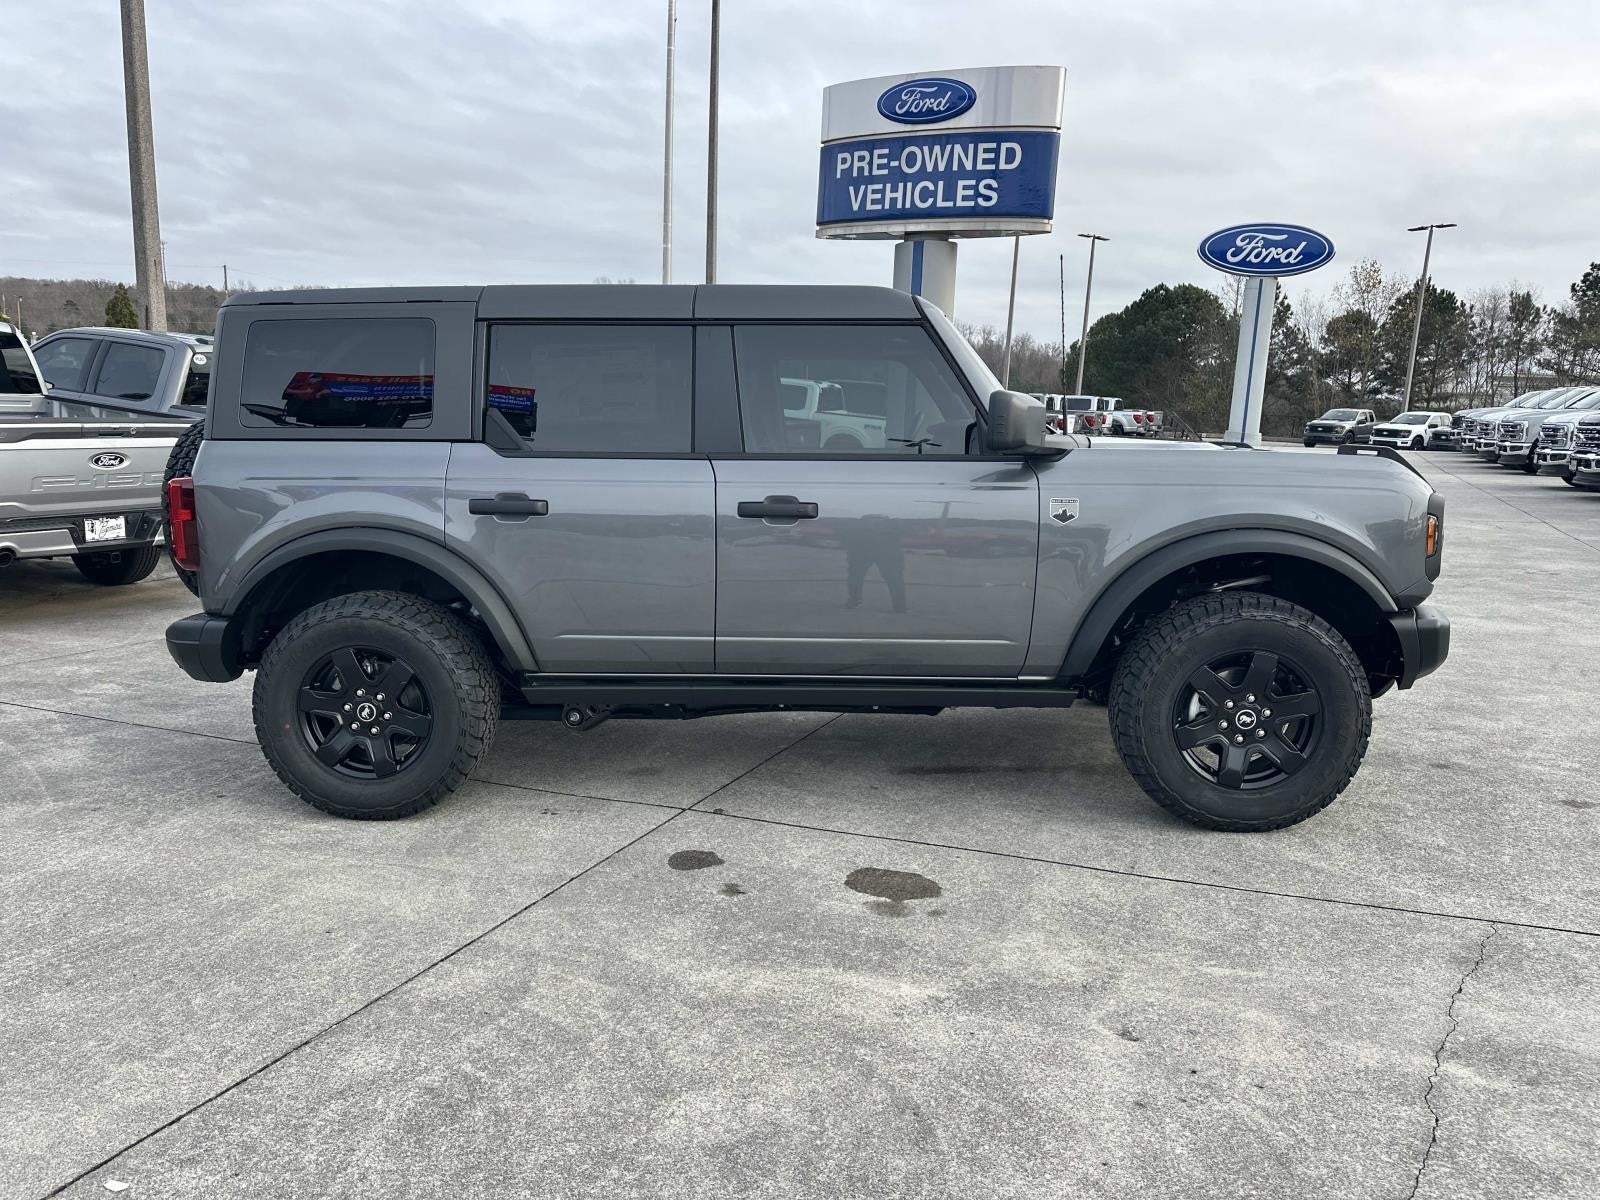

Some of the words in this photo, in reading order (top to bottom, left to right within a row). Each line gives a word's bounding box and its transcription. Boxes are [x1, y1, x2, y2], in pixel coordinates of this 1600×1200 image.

[895, 86, 952, 114] Ford
[836, 142, 1023, 179] PRE-OWNED
[849, 178, 999, 212] VEHICLES
[1226, 232, 1308, 264] Ford
[98, 455, 121, 466] Ford
